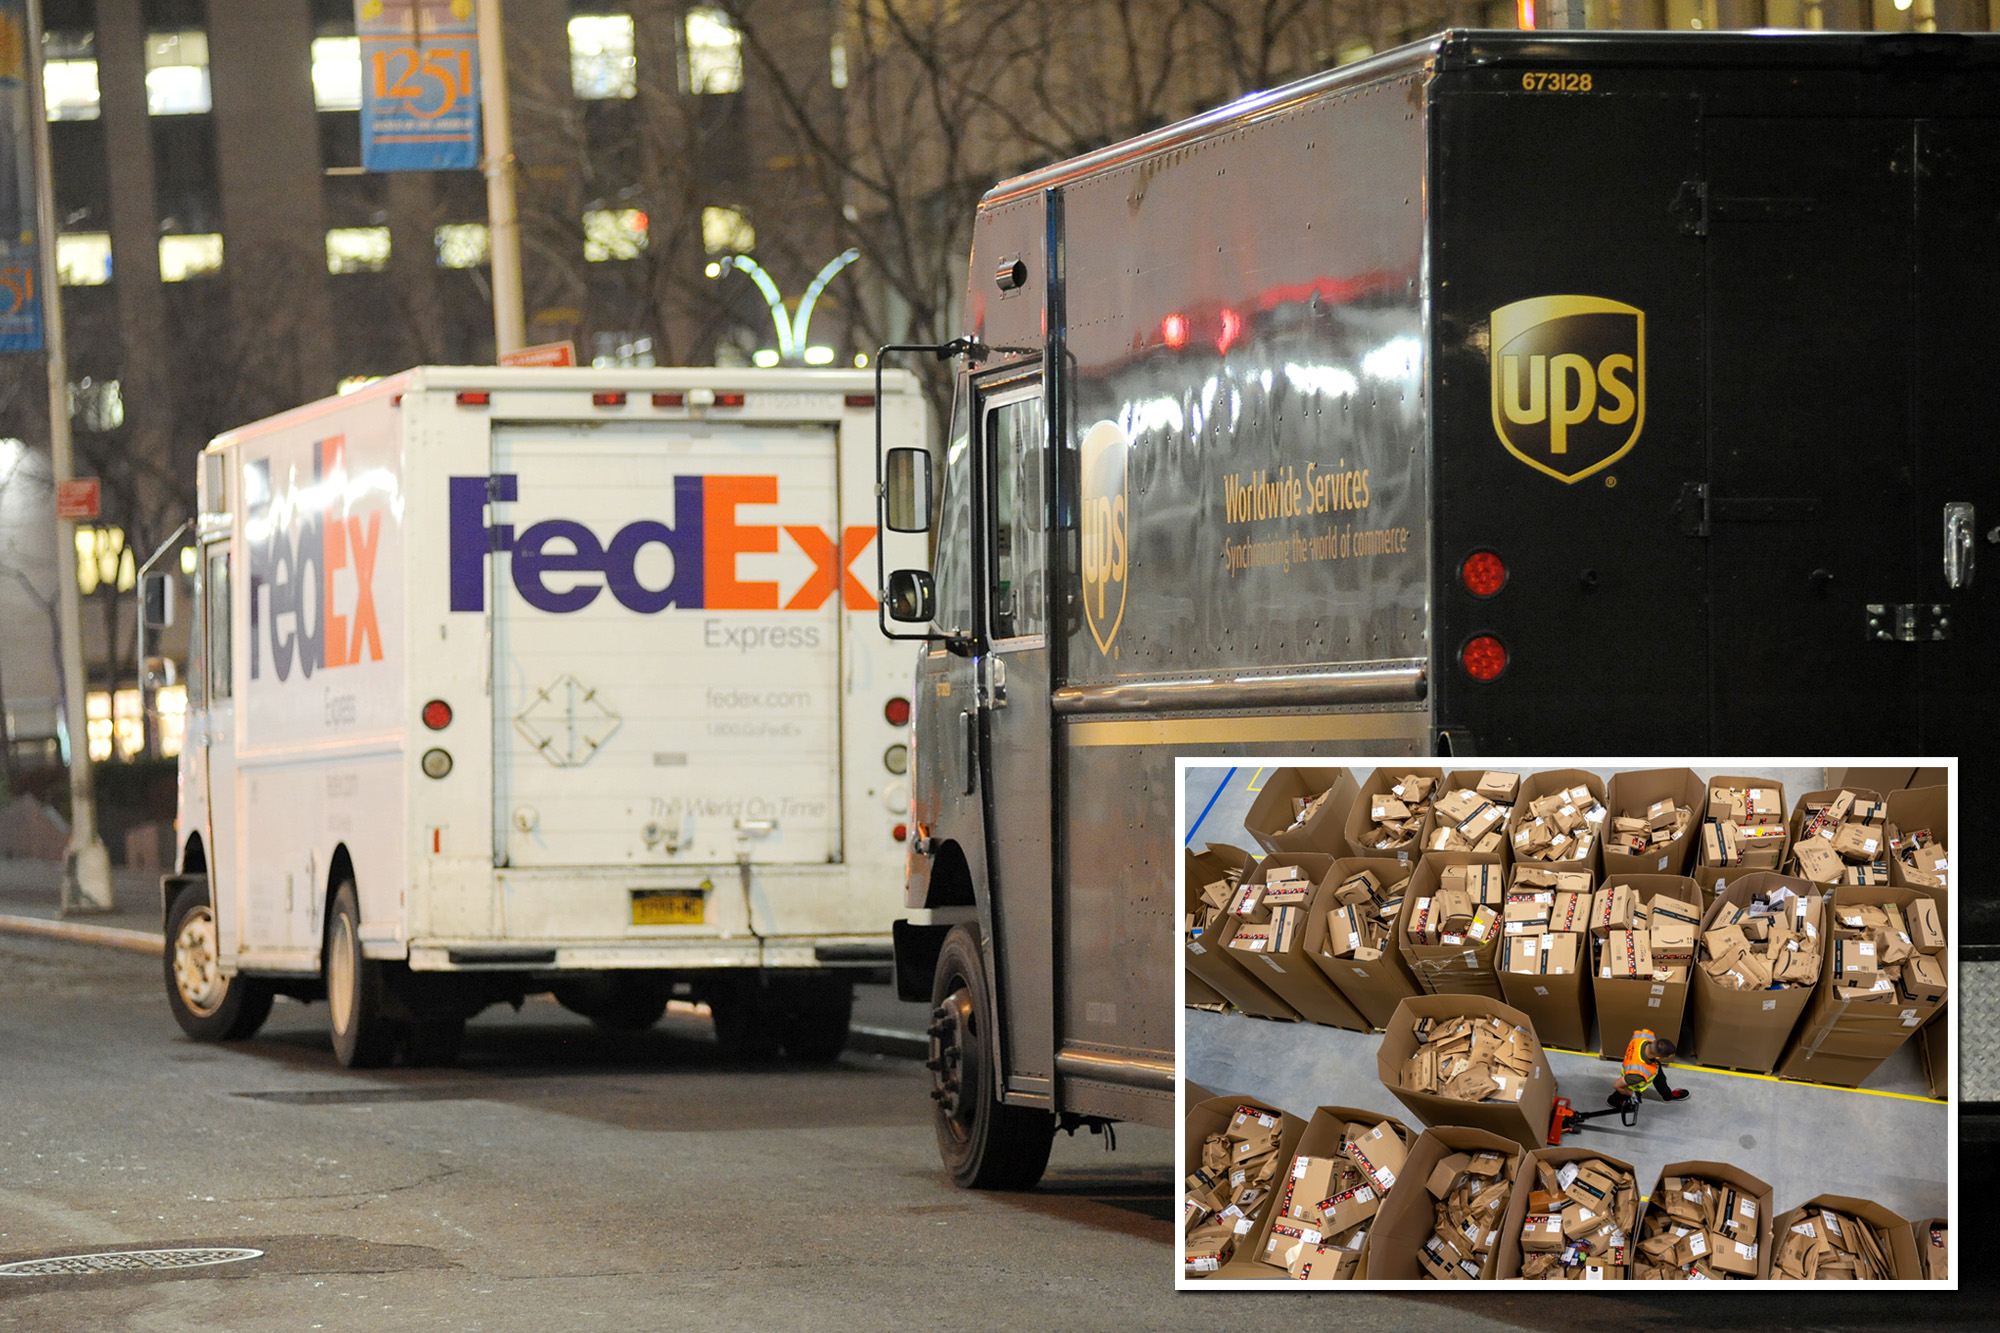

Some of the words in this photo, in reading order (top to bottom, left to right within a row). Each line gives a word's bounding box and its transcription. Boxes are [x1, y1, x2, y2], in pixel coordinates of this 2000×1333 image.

[371, 46, 471, 118] 1251
[1522, 72, 1593, 92] 673128
[1224, 464, 1302, 524] Worldwide
[1306, 457, 1370, 515] Services
[449, 474, 880, 613] FedEx
[1292, 529, 1308, 563] the
[1310, 525, 1338, 561] world
[1340, 523, 1351, 559] of
[1353, 527, 1407, 557] commerce
[704, 618, 820, 654] Express
[705, 686, 812, 708] fedex.com
[746, 796, 775, 817] On
[779, 797, 826, 818] Time
